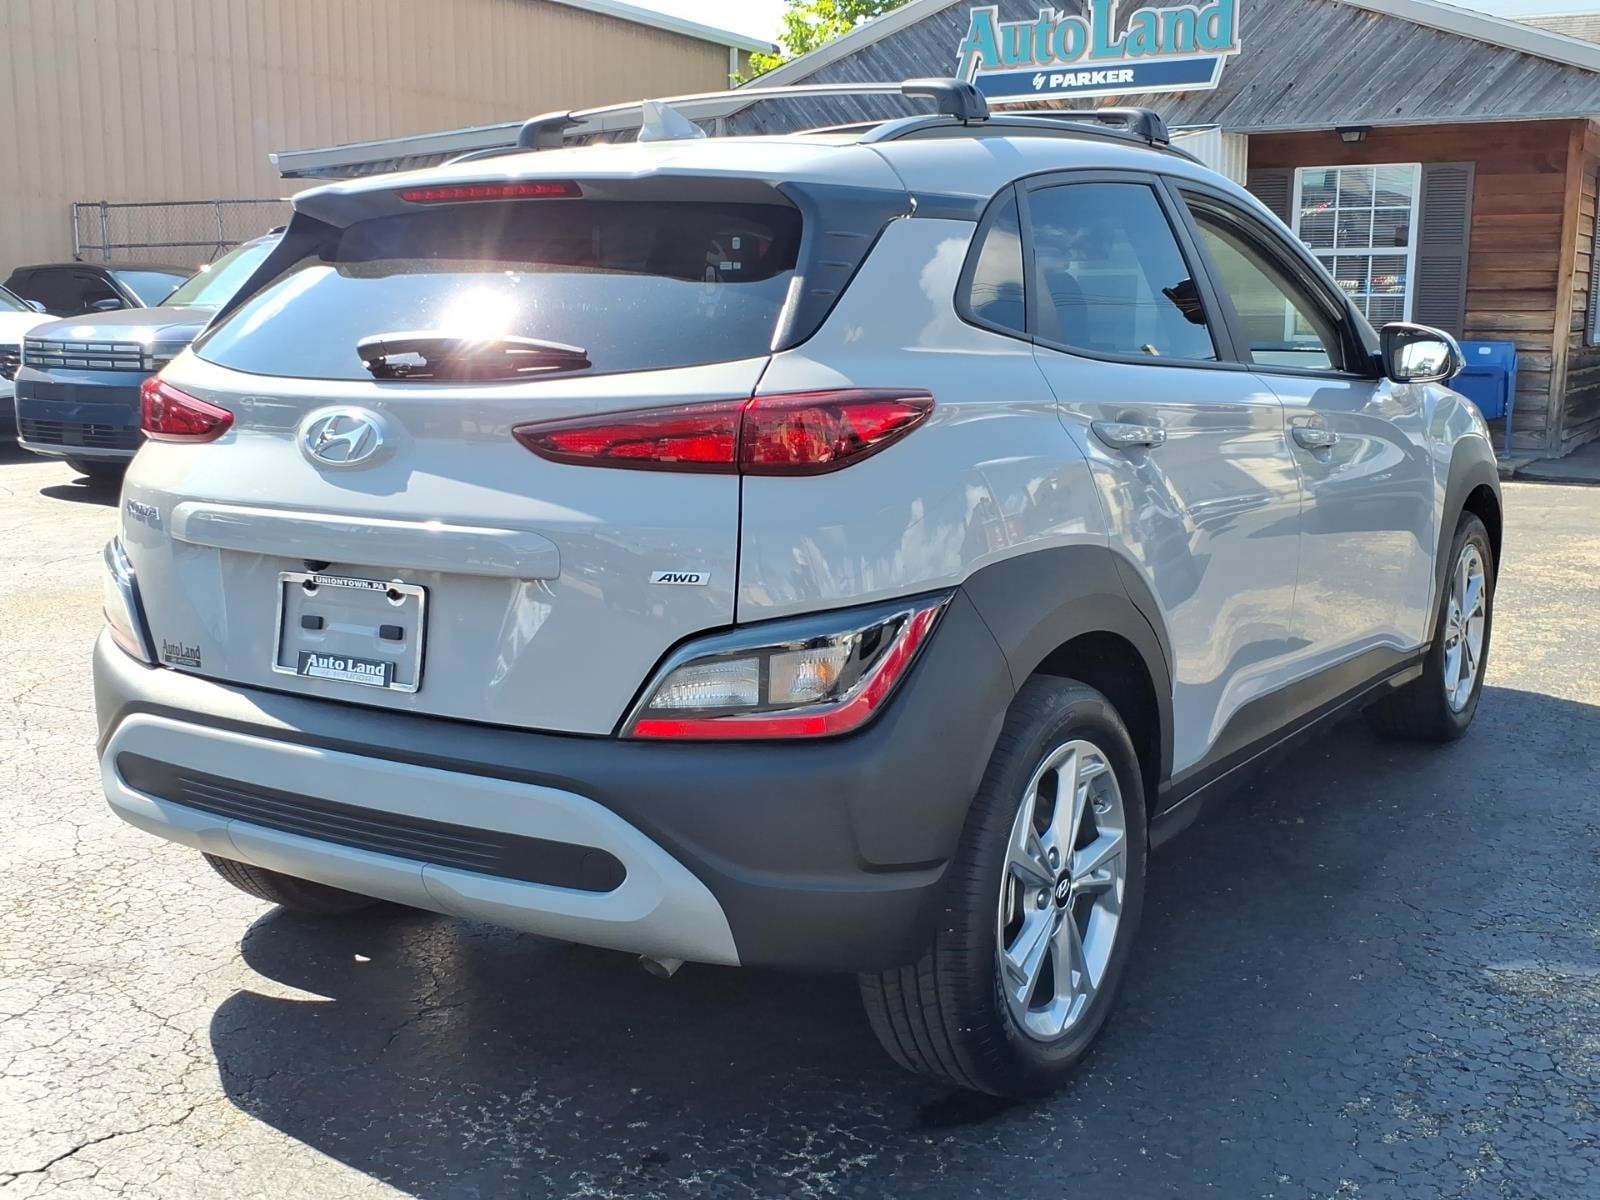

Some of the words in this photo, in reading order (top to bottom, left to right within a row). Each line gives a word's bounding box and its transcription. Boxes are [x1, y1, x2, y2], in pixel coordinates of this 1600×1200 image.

[1032, 72, 1046, 90] by
[1049, 69, 1135, 88] PARKER
[315, 576, 372, 589] UNIONTOWN,
[657, 573, 700, 583] AWD
